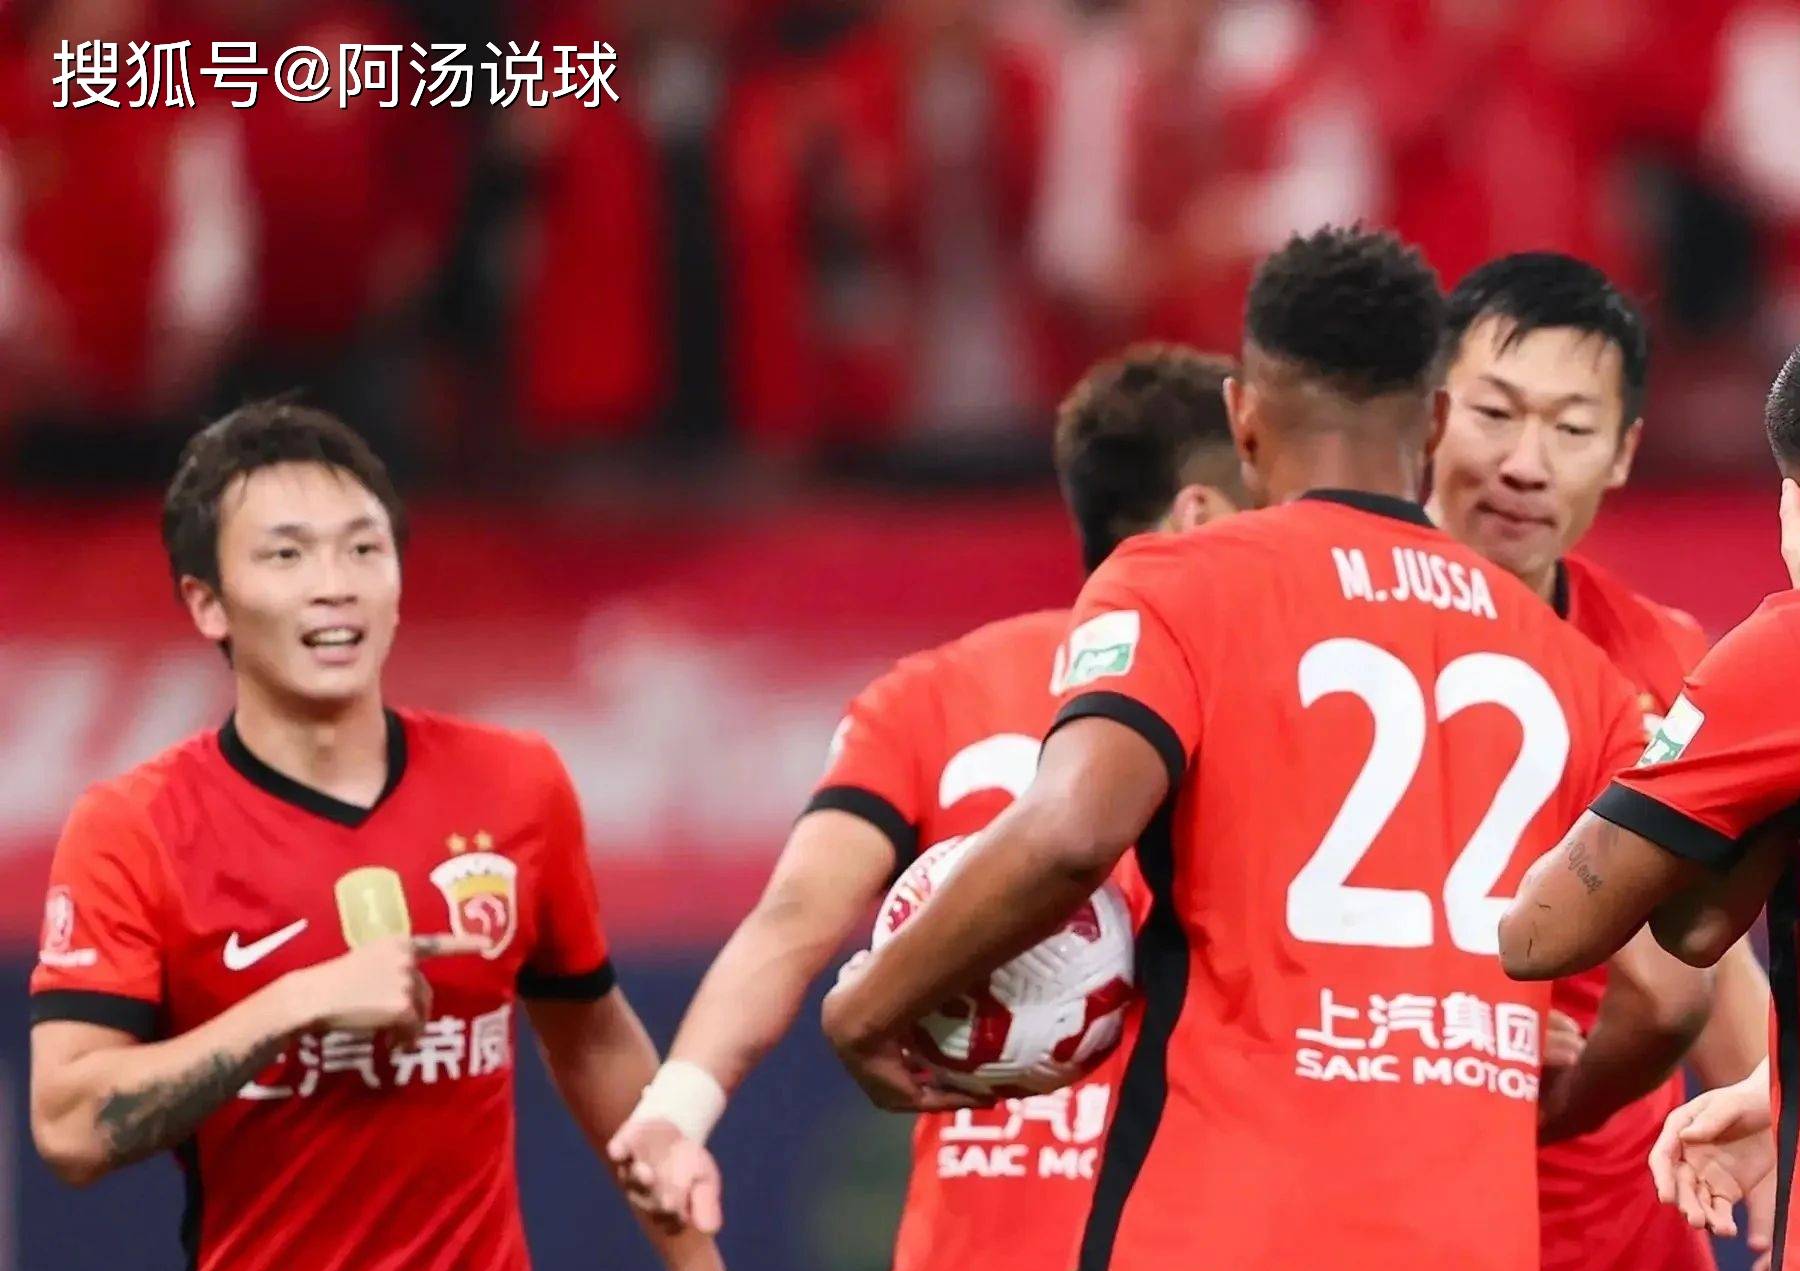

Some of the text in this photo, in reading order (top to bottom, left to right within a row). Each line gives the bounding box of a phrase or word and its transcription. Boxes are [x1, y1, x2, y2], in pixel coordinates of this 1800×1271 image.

[1287, 637, 1569, 955] 22
[1295, 987, 1541, 1068] 上汽集团
[1294, 1047, 1400, 1082] SAIC
[937, 1144, 1028, 1178] SAIC
